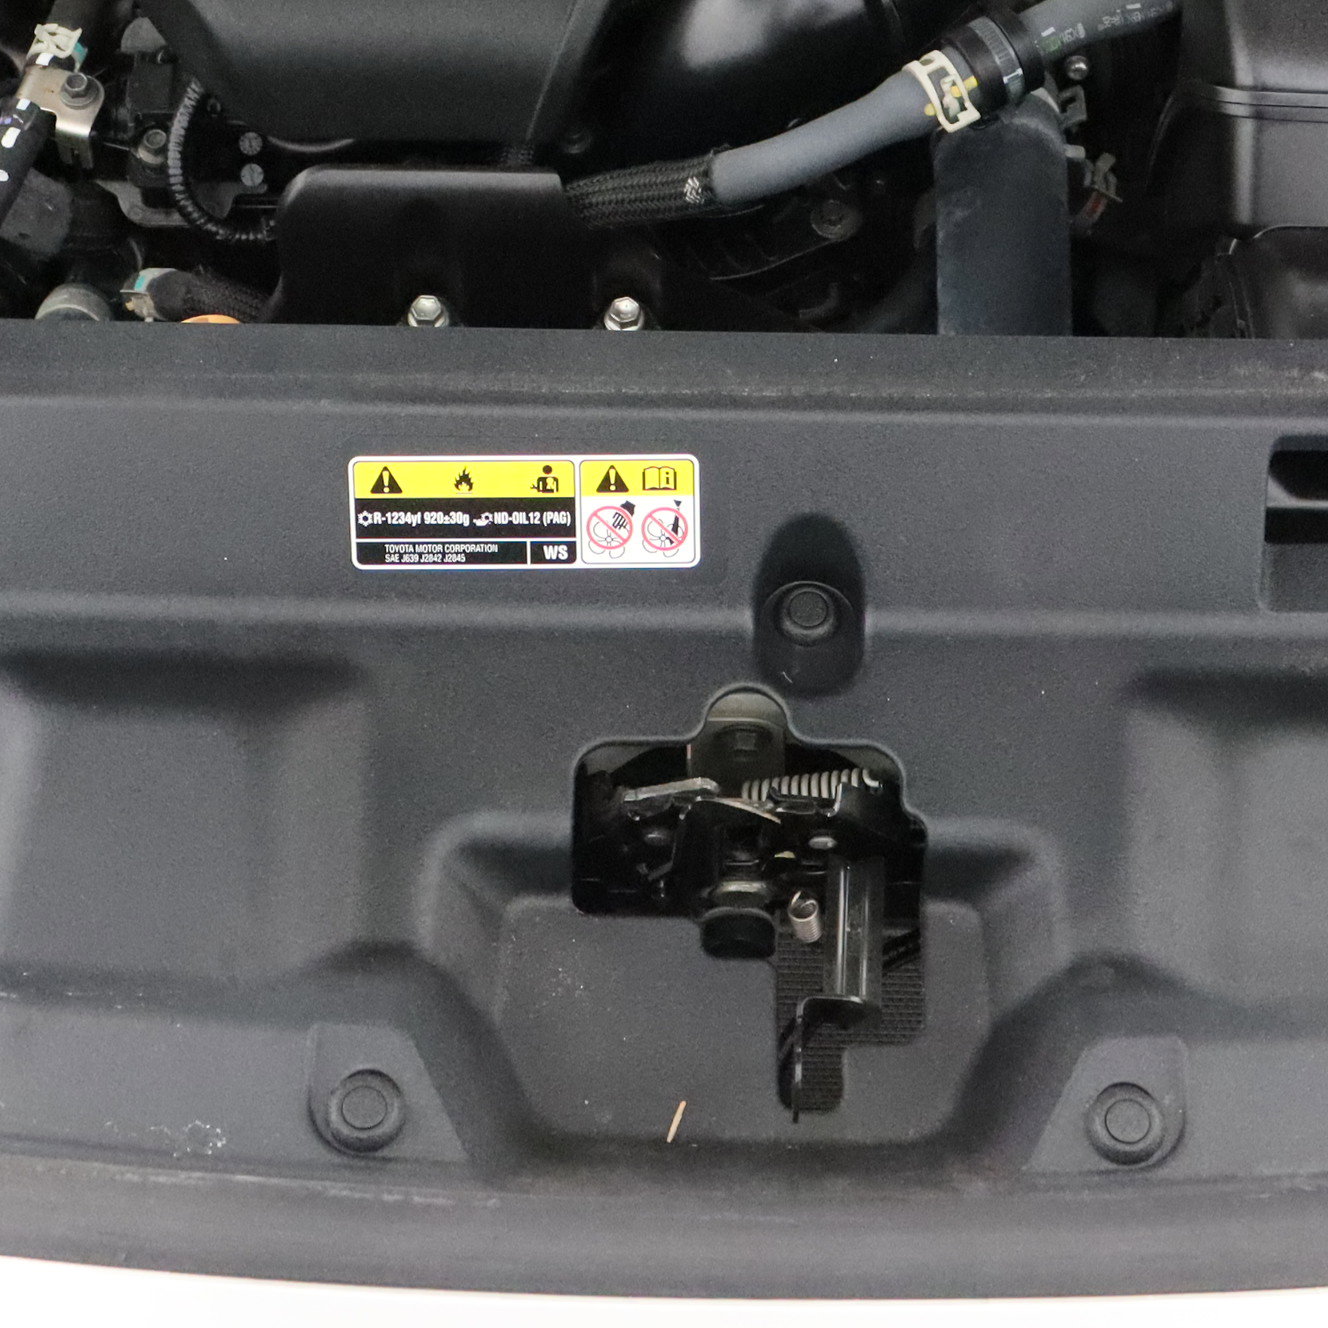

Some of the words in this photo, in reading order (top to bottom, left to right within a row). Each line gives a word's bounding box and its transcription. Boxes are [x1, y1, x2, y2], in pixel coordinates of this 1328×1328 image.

[373, 511, 421, 527] R-1234yf
[423, 511, 470, 527] 920±30g
[493, 511, 541, 525] ND-OIL12
[542, 511, 572, 527] (PAG)
[384, 544, 414, 553] TOYOTA
[415, 544, 443, 553] MOTOR
[444, 543, 499, 553] CORPORATION
[543, 545, 569, 561] WS
[384, 553, 399, 563] SAE
